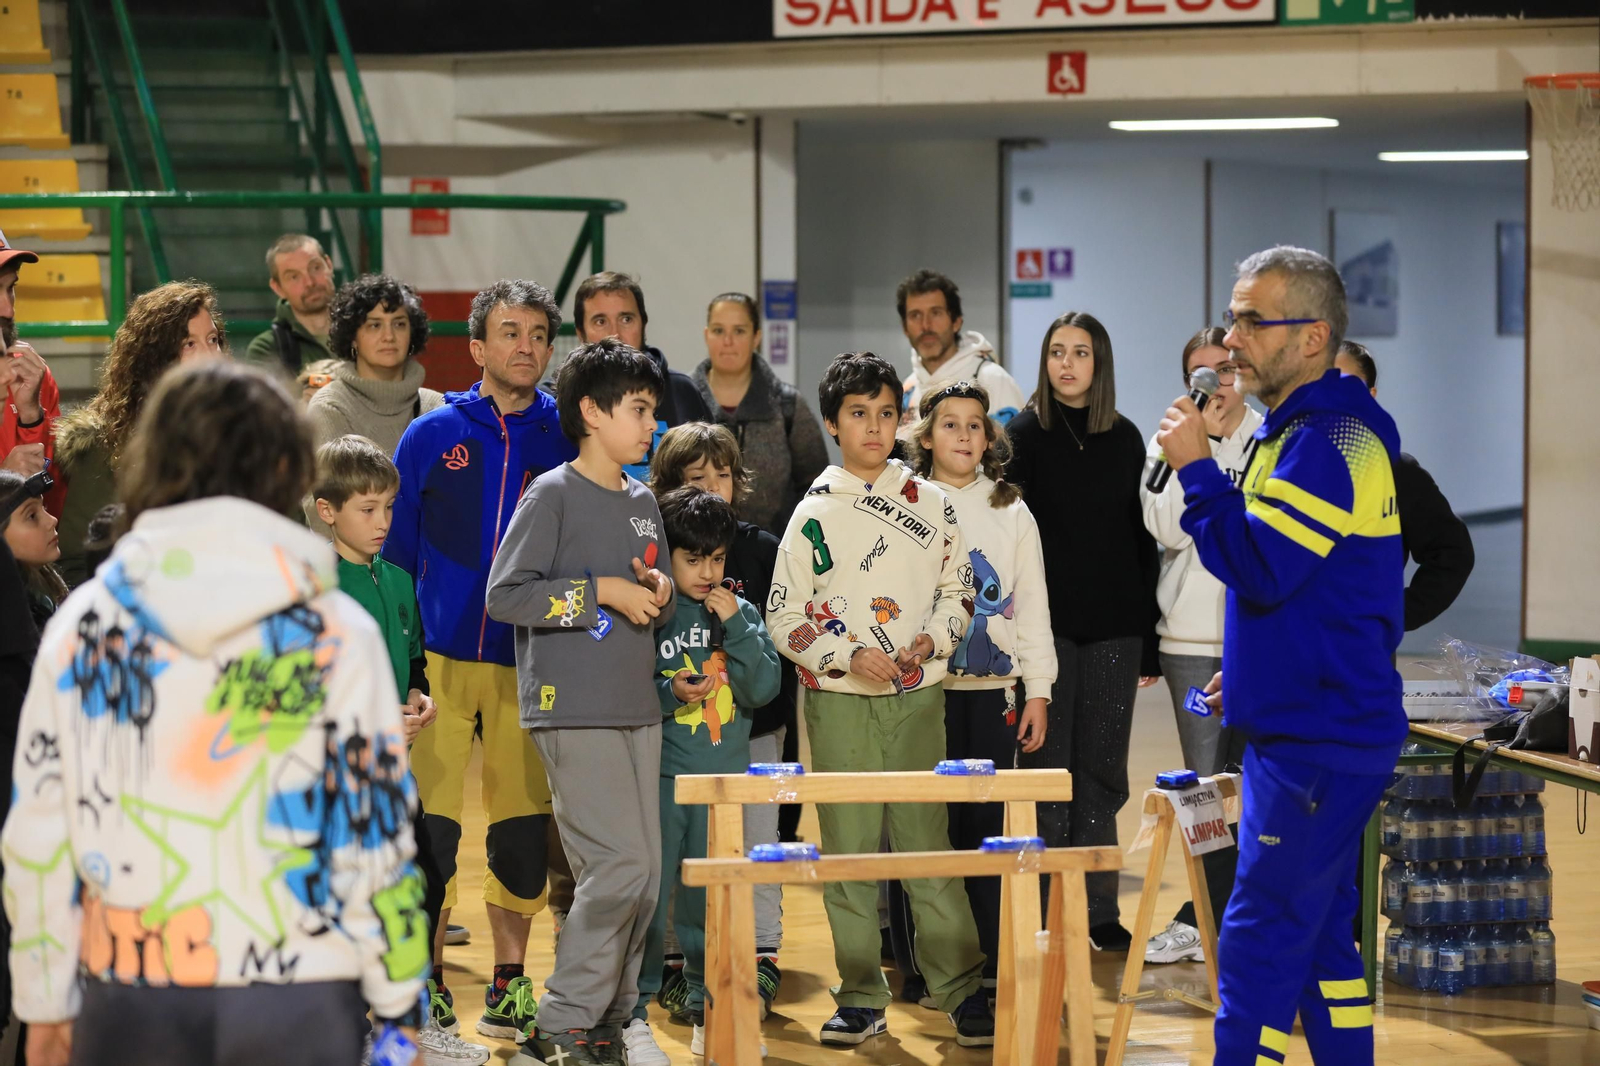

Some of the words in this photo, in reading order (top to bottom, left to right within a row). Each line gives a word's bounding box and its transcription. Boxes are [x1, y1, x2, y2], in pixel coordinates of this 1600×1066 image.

[861, 496, 895, 516] NEW
[895, 511, 931, 540] YORK
[860, 534, 888, 572] Bulls
[870, 597, 901, 620] KNICKS
[870, 625, 895, 654] MIAMI
[1185, 818, 1228, 845] LIMPAR
